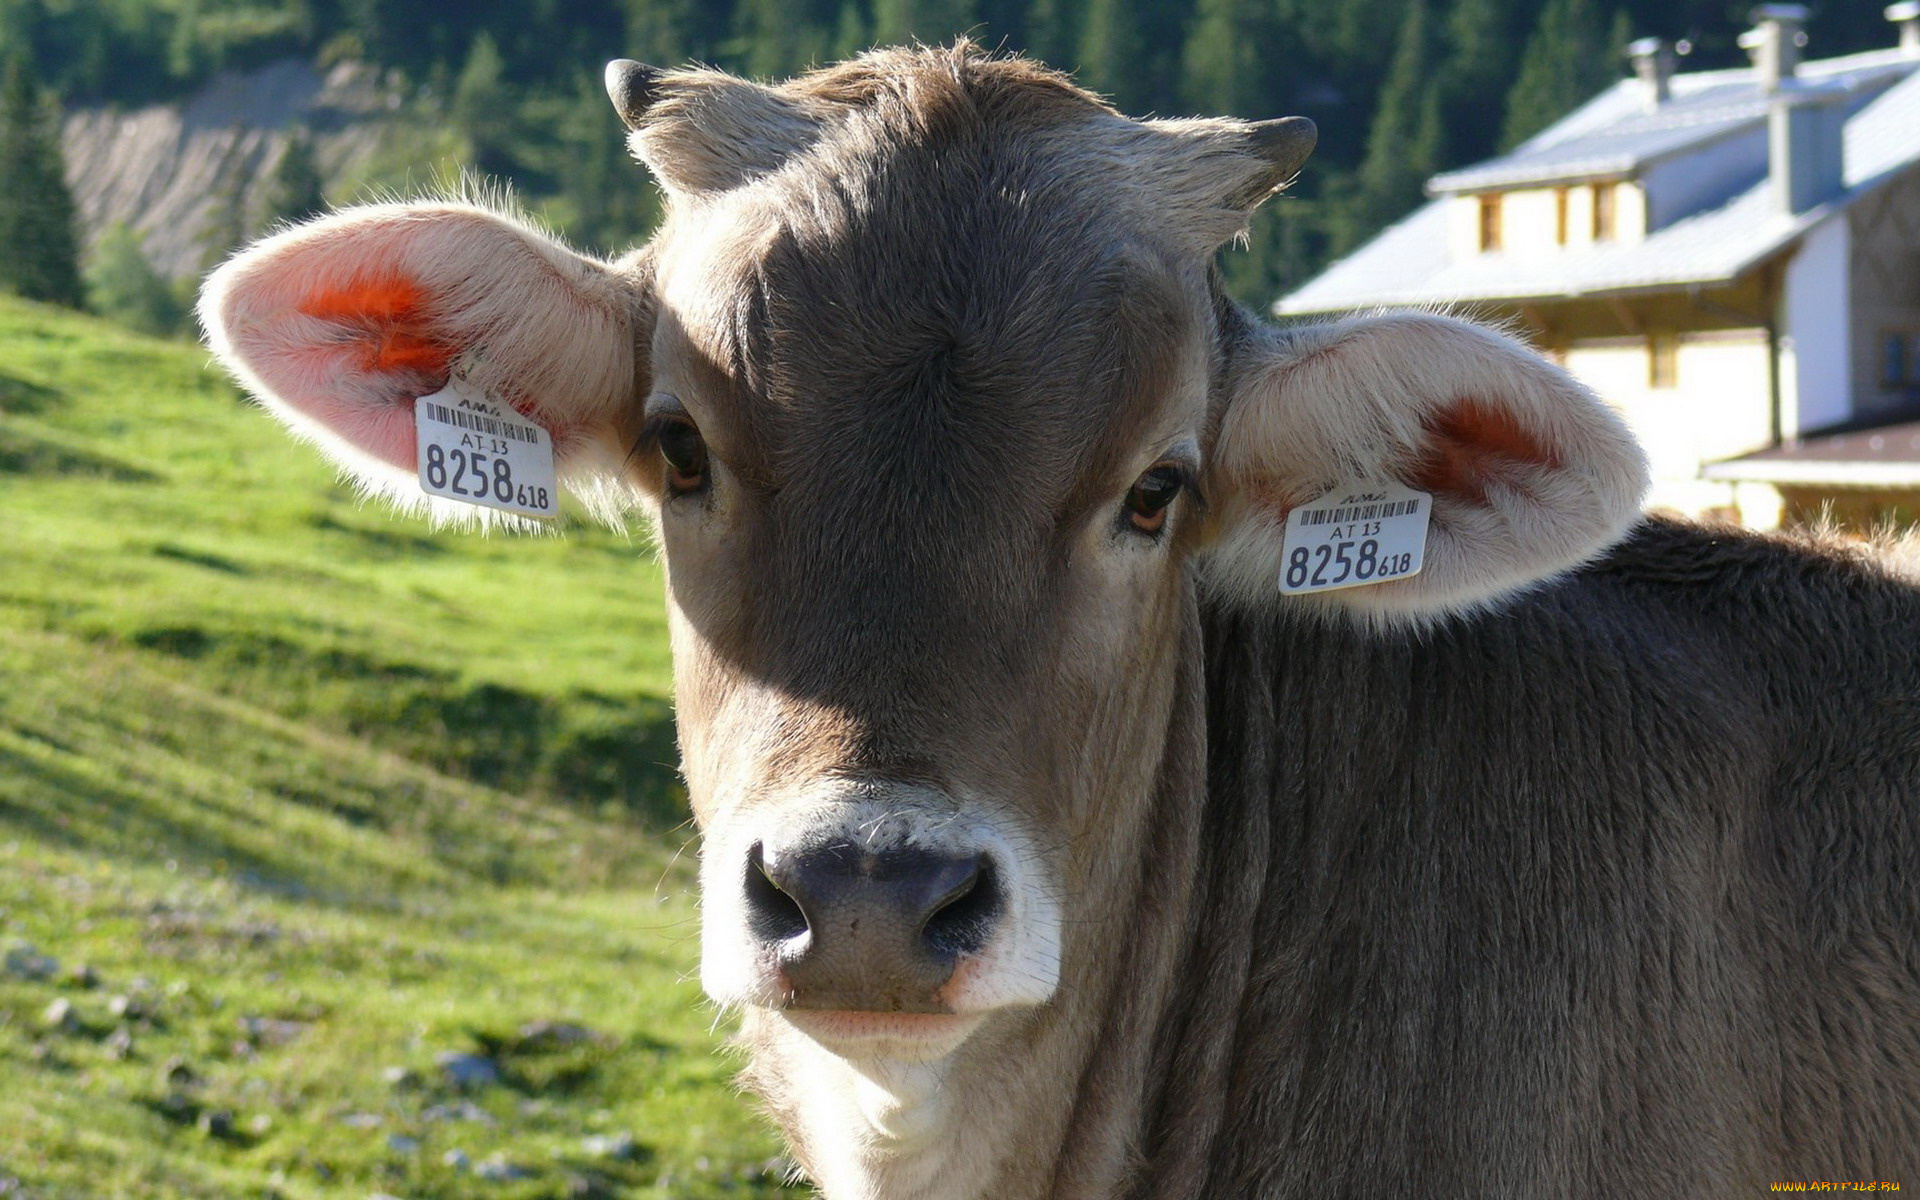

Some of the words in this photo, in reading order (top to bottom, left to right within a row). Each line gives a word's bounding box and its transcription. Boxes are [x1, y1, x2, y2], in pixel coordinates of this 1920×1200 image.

[461, 433, 483, 450] AT
[491, 439, 509, 455] 13
[1330, 524, 1356, 541] AT
[1362, 521, 1381, 537] 13
